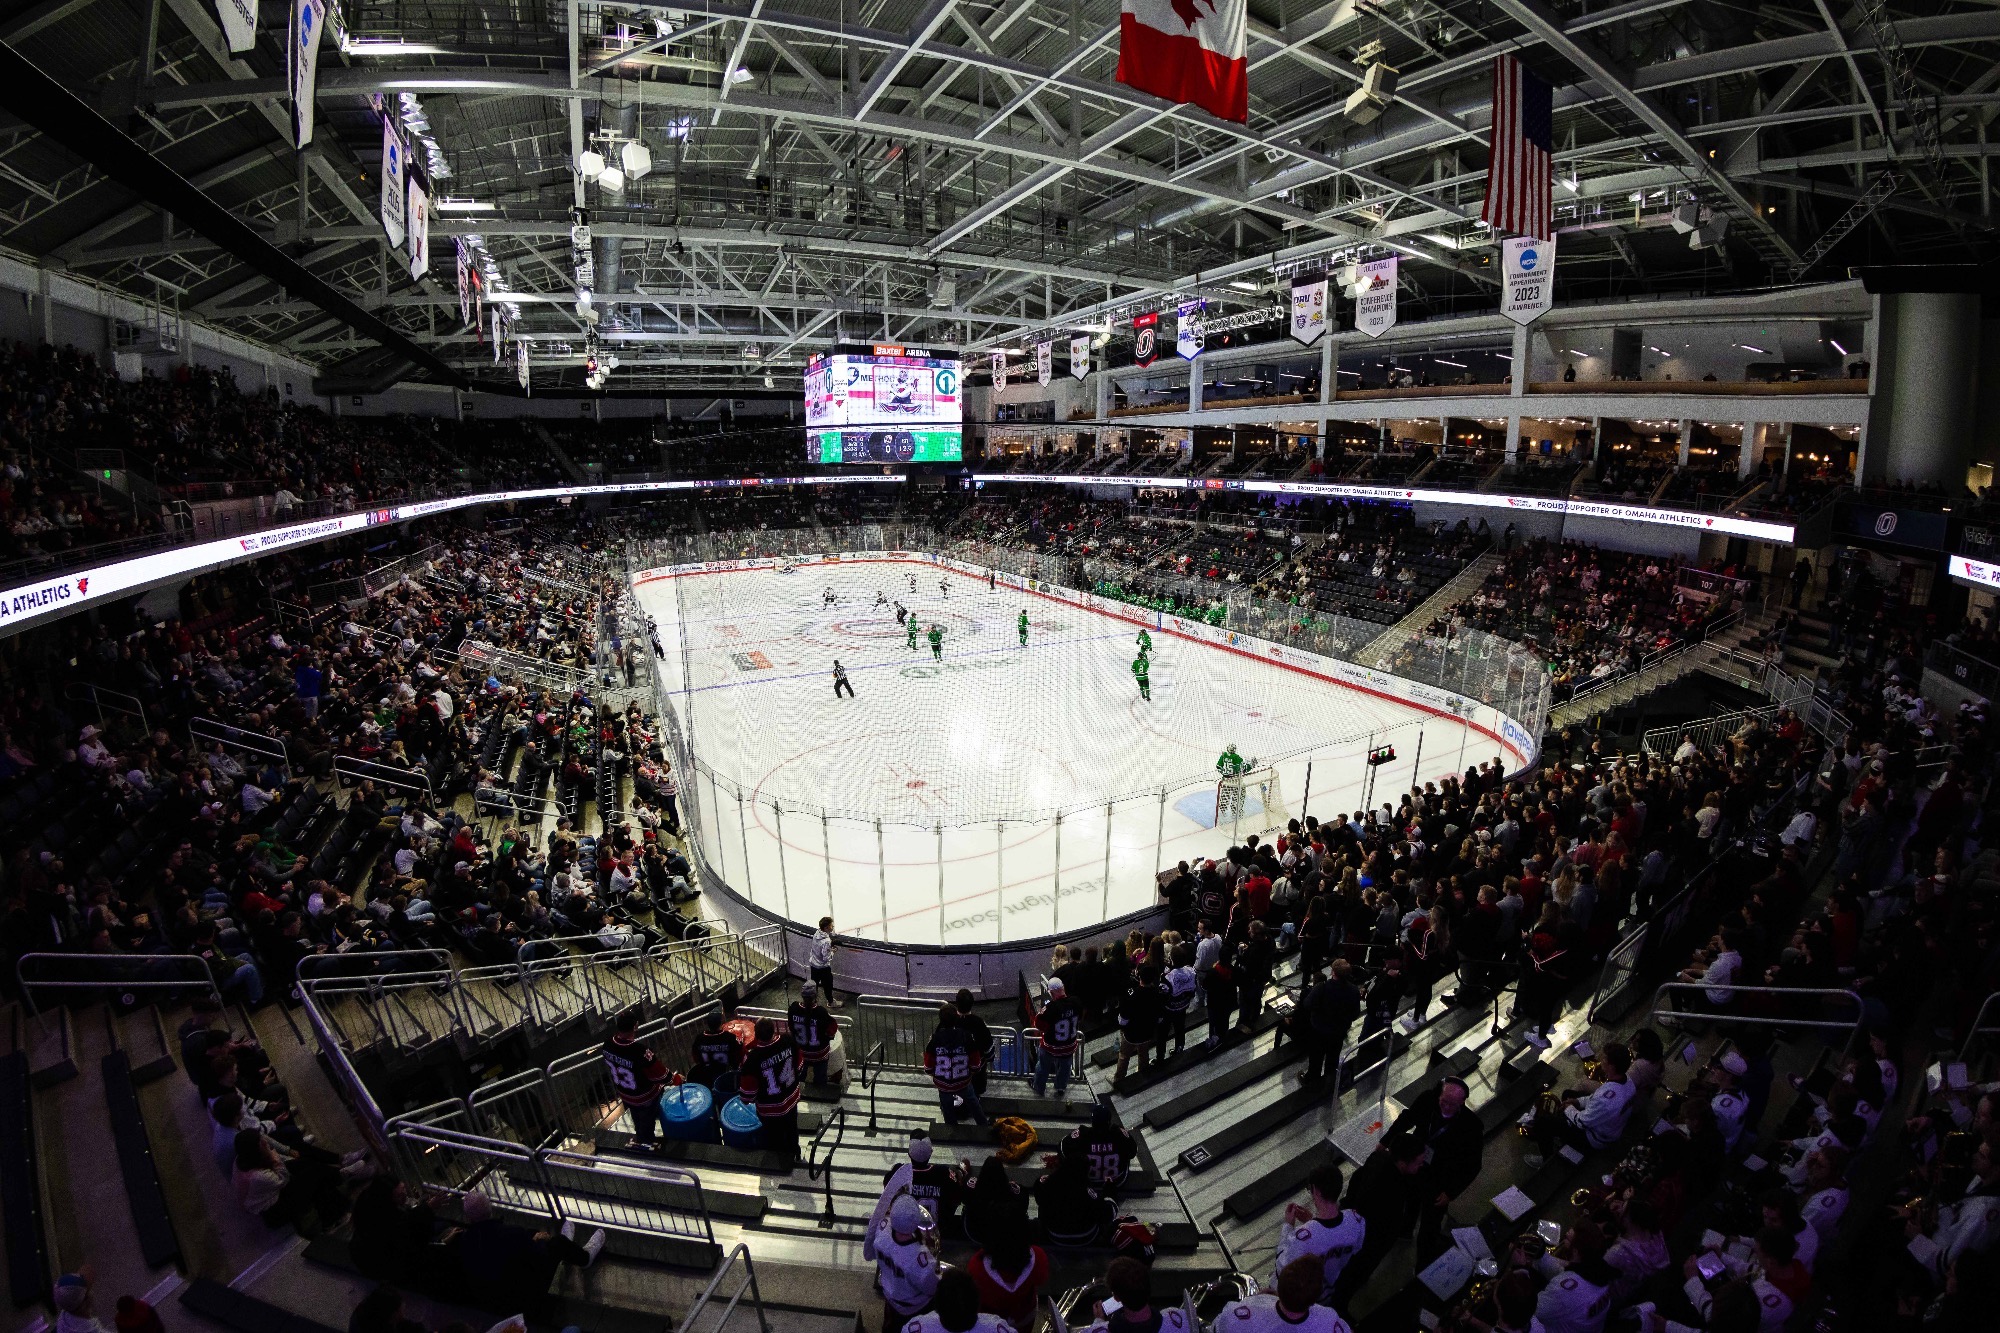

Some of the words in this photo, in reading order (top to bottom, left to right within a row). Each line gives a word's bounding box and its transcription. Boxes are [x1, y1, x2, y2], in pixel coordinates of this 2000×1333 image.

[1509, 269, 1547, 280] TOURNAMENT
[1509, 277, 1546, 287] APPEARANCE
[1360, 293, 1394, 306] CONFERENCE
[1514, 286, 1540, 302] 2023
[1360, 302, 1394, 315] CHAMPIONS
[1508, 301, 1543, 312] LAWRENCE
[876, 346, 902, 355] Baxter
[906, 349, 931, 357] ARENA
[1537, 501, 1565, 511] PROUD
[1565, 503, 1610, 515] SUPPORTER
[1611, 508, 1623, 516] OF
[1625, 510, 1657, 520] OMAHA
[1659, 513, 1702, 525] ATHLETICS
[1701, 580, 1714, 590] 107
[13, 583, 71, 614] ATHLETICS
[1955, 664, 1968, 678] 109
[943, 909, 1000, 933] Solar
[795, 1024, 820, 1046] 31
[1055, 1016, 1079, 1042] 91
[935, 1055, 970, 1079] 22
[762, 1058, 795, 1095] 14
[1091, 1143, 1113, 1152] BEAN
